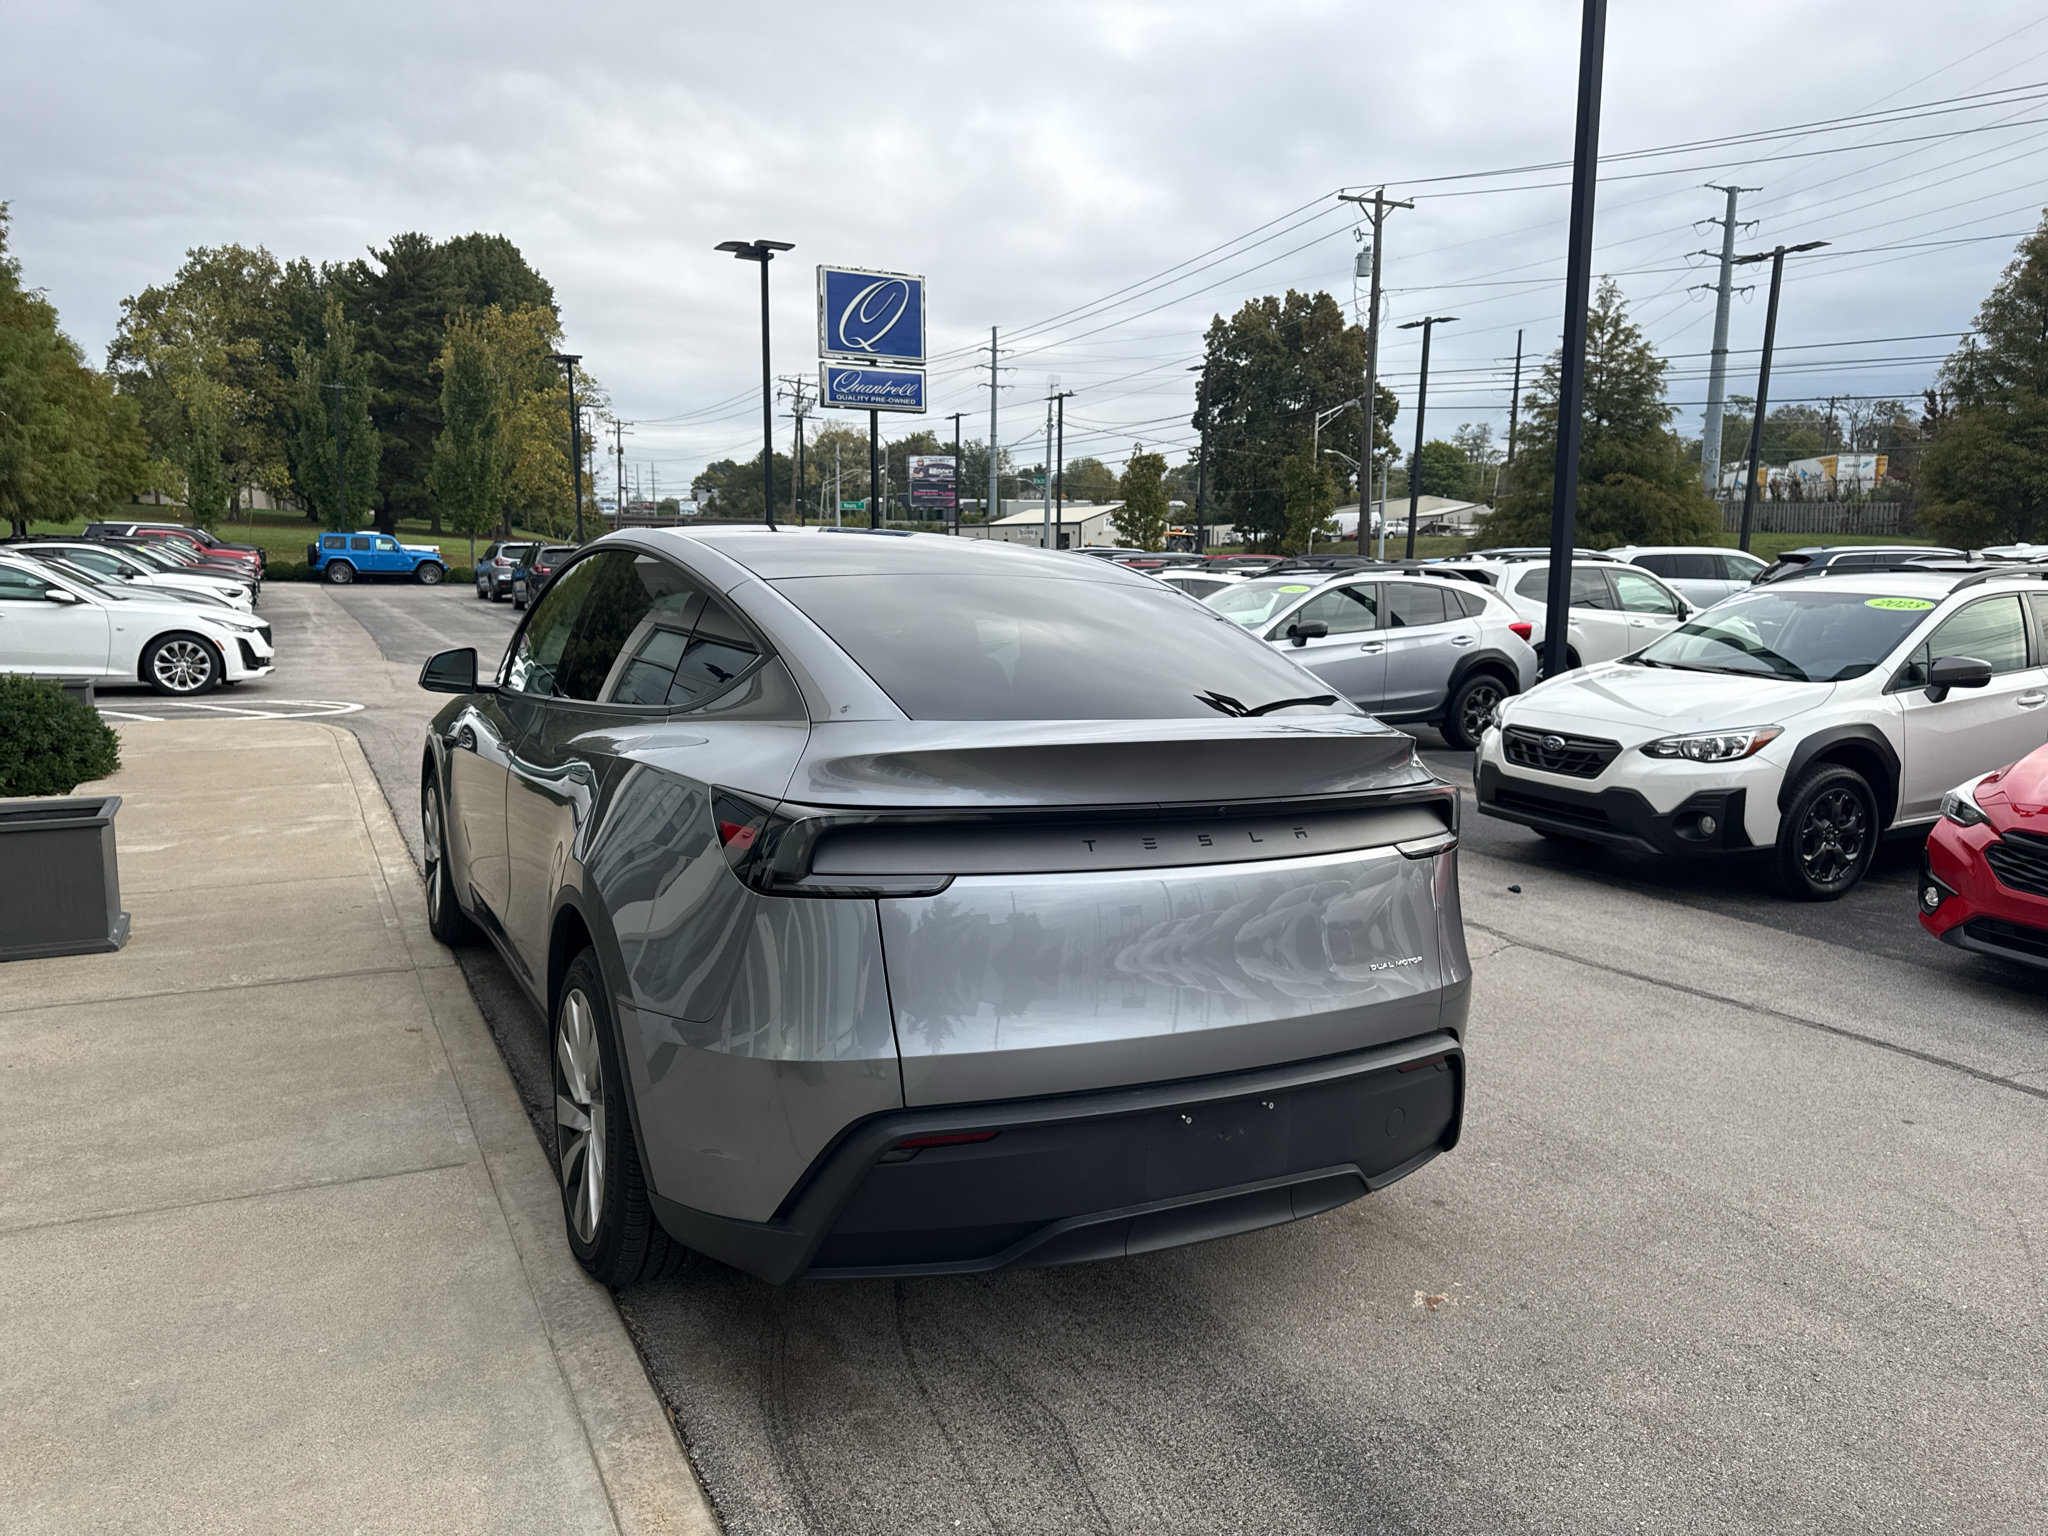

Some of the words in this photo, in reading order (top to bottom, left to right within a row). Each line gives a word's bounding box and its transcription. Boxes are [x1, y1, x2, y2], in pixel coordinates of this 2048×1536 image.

[839, 279, 909, 353] Q
[833, 370, 918, 396] Quantrell
[836, 394, 869, 402] QUALITY
[870, 396, 916, 405] PRE-OWNED
[1082, 827, 1308, 852] TESLA
[1370, 962, 1394, 971] DUAL
[1395, 956, 1423, 966] MOTOR
